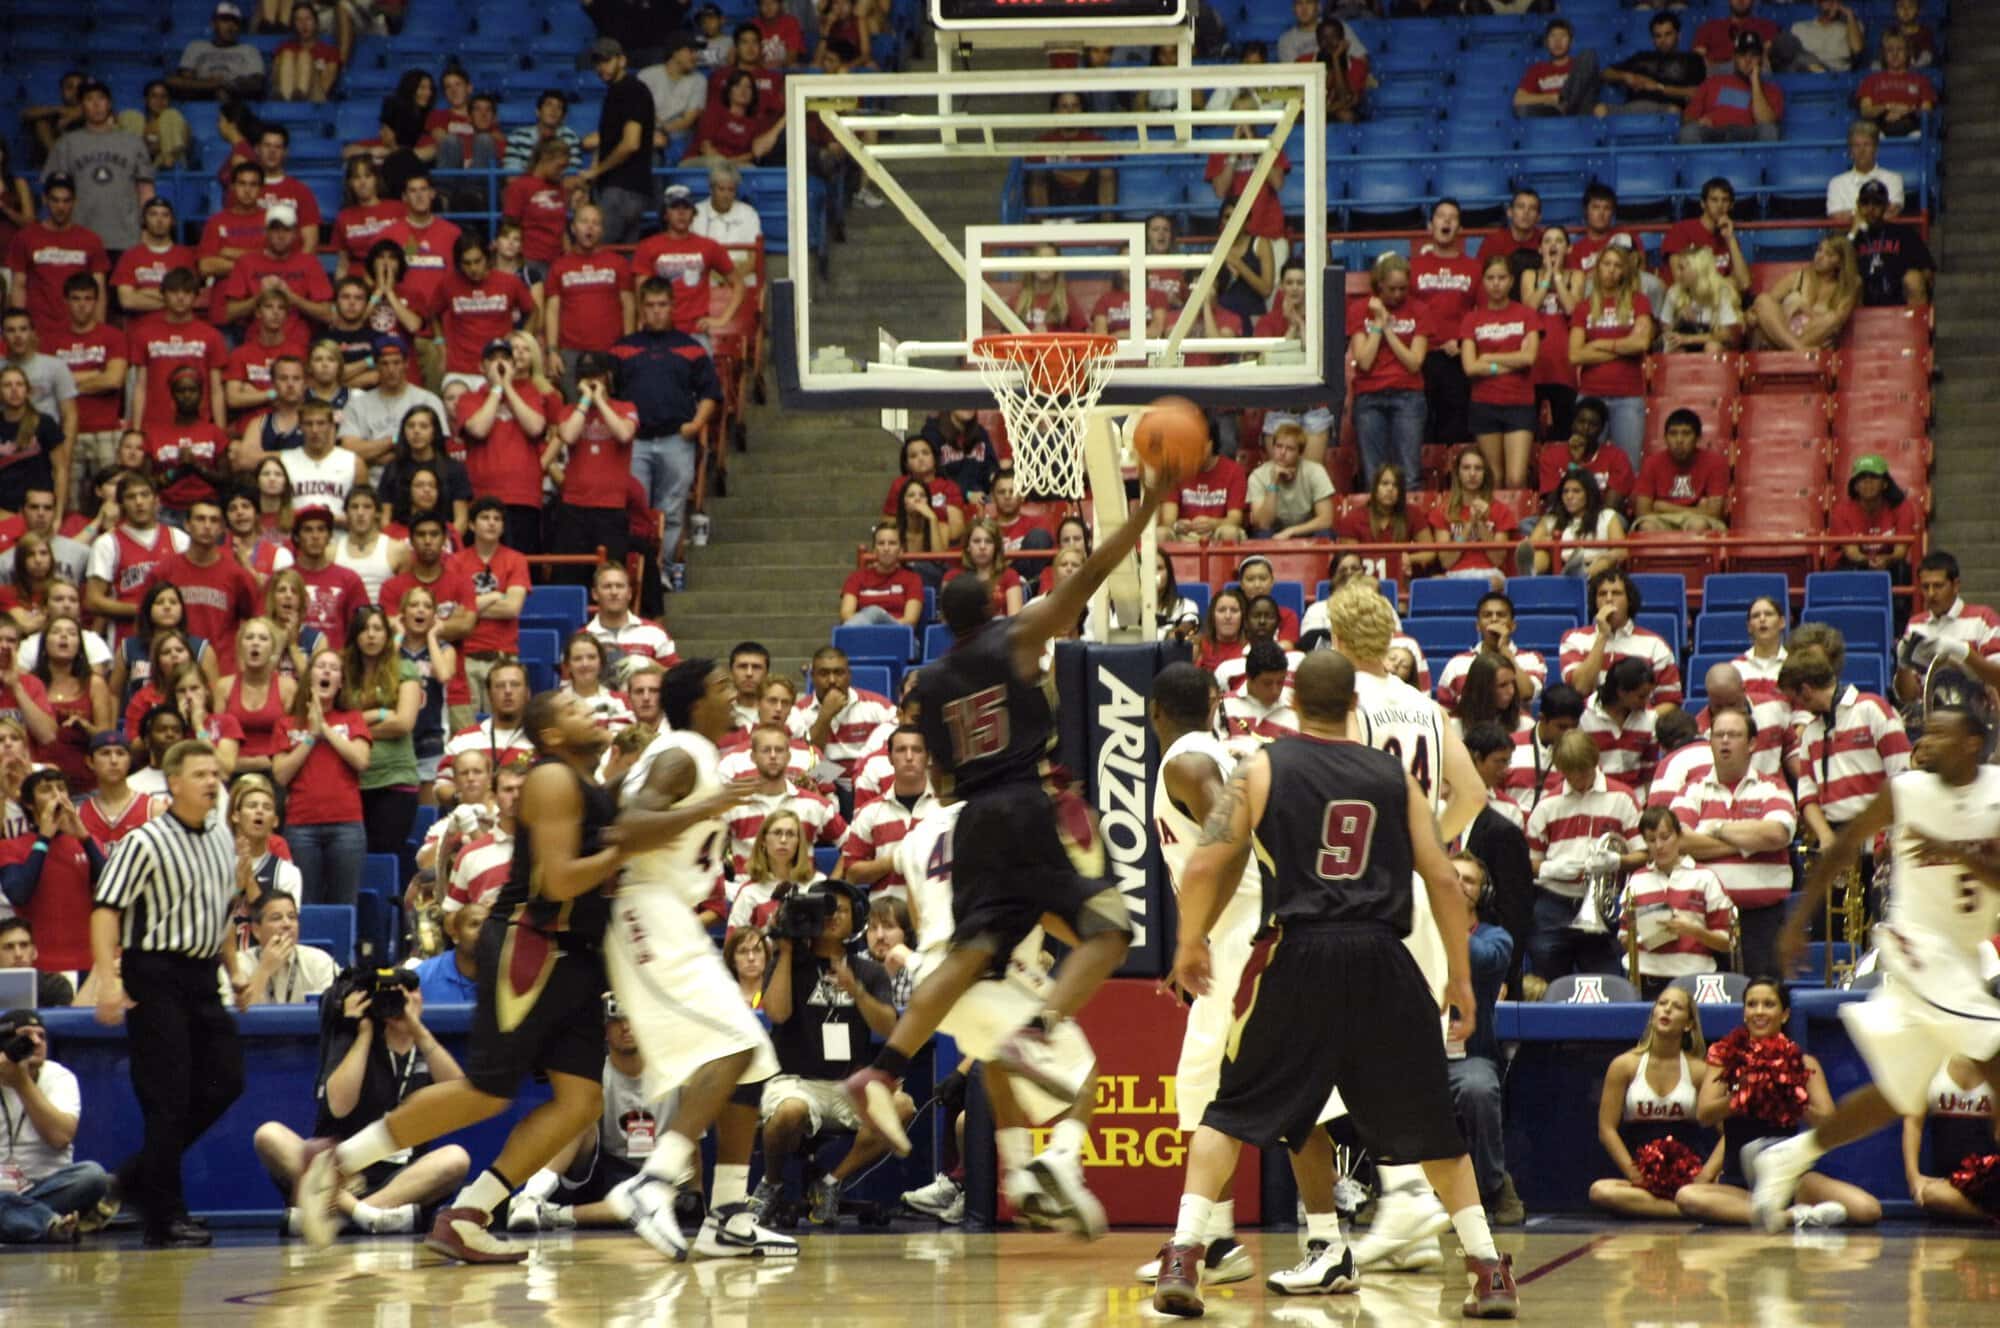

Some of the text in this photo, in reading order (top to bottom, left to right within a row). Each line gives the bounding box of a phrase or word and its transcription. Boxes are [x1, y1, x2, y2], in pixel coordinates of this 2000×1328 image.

[942, 683, 1011, 767] 15
[1315, 799, 1378, 880] 9
[1091, 1075, 1179, 1114] ELL
[1028, 1127, 1188, 1168] FARG
